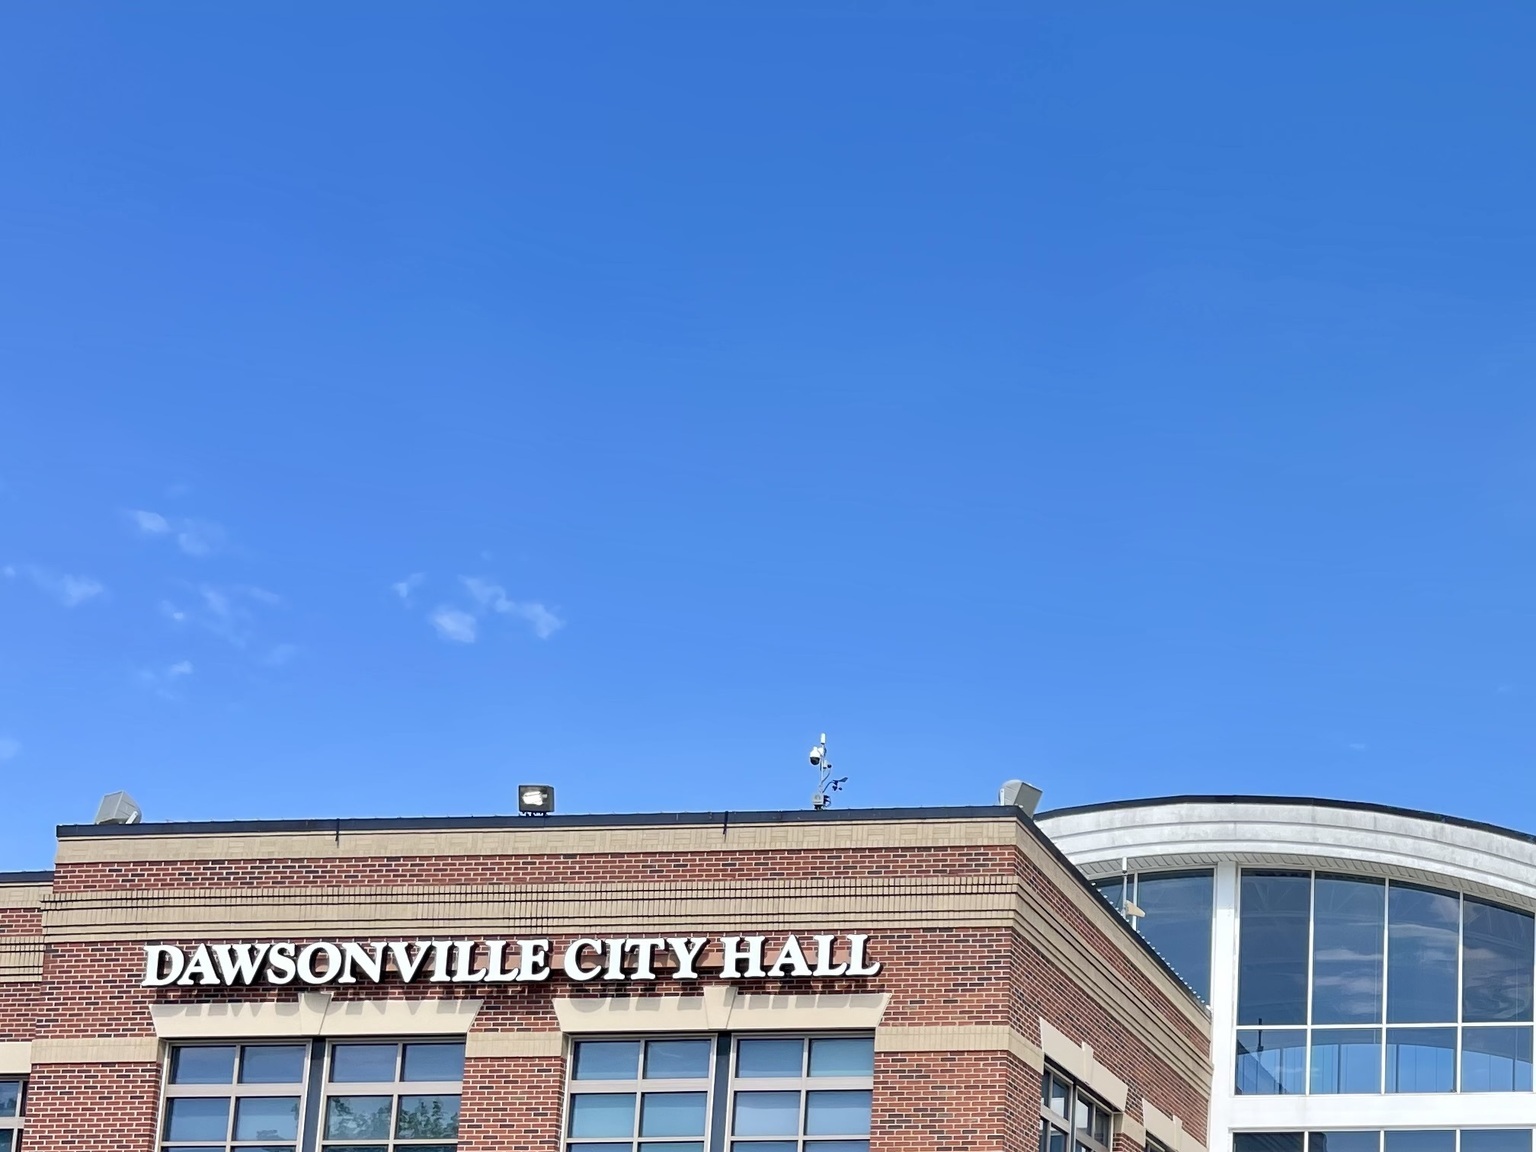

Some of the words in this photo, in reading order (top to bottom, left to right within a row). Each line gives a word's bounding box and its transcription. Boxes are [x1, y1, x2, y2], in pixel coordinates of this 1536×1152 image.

[141, 939, 550, 987] DAWSONVILLE
[564, 937, 708, 981] CITY
[719, 934, 880, 979] HALL
